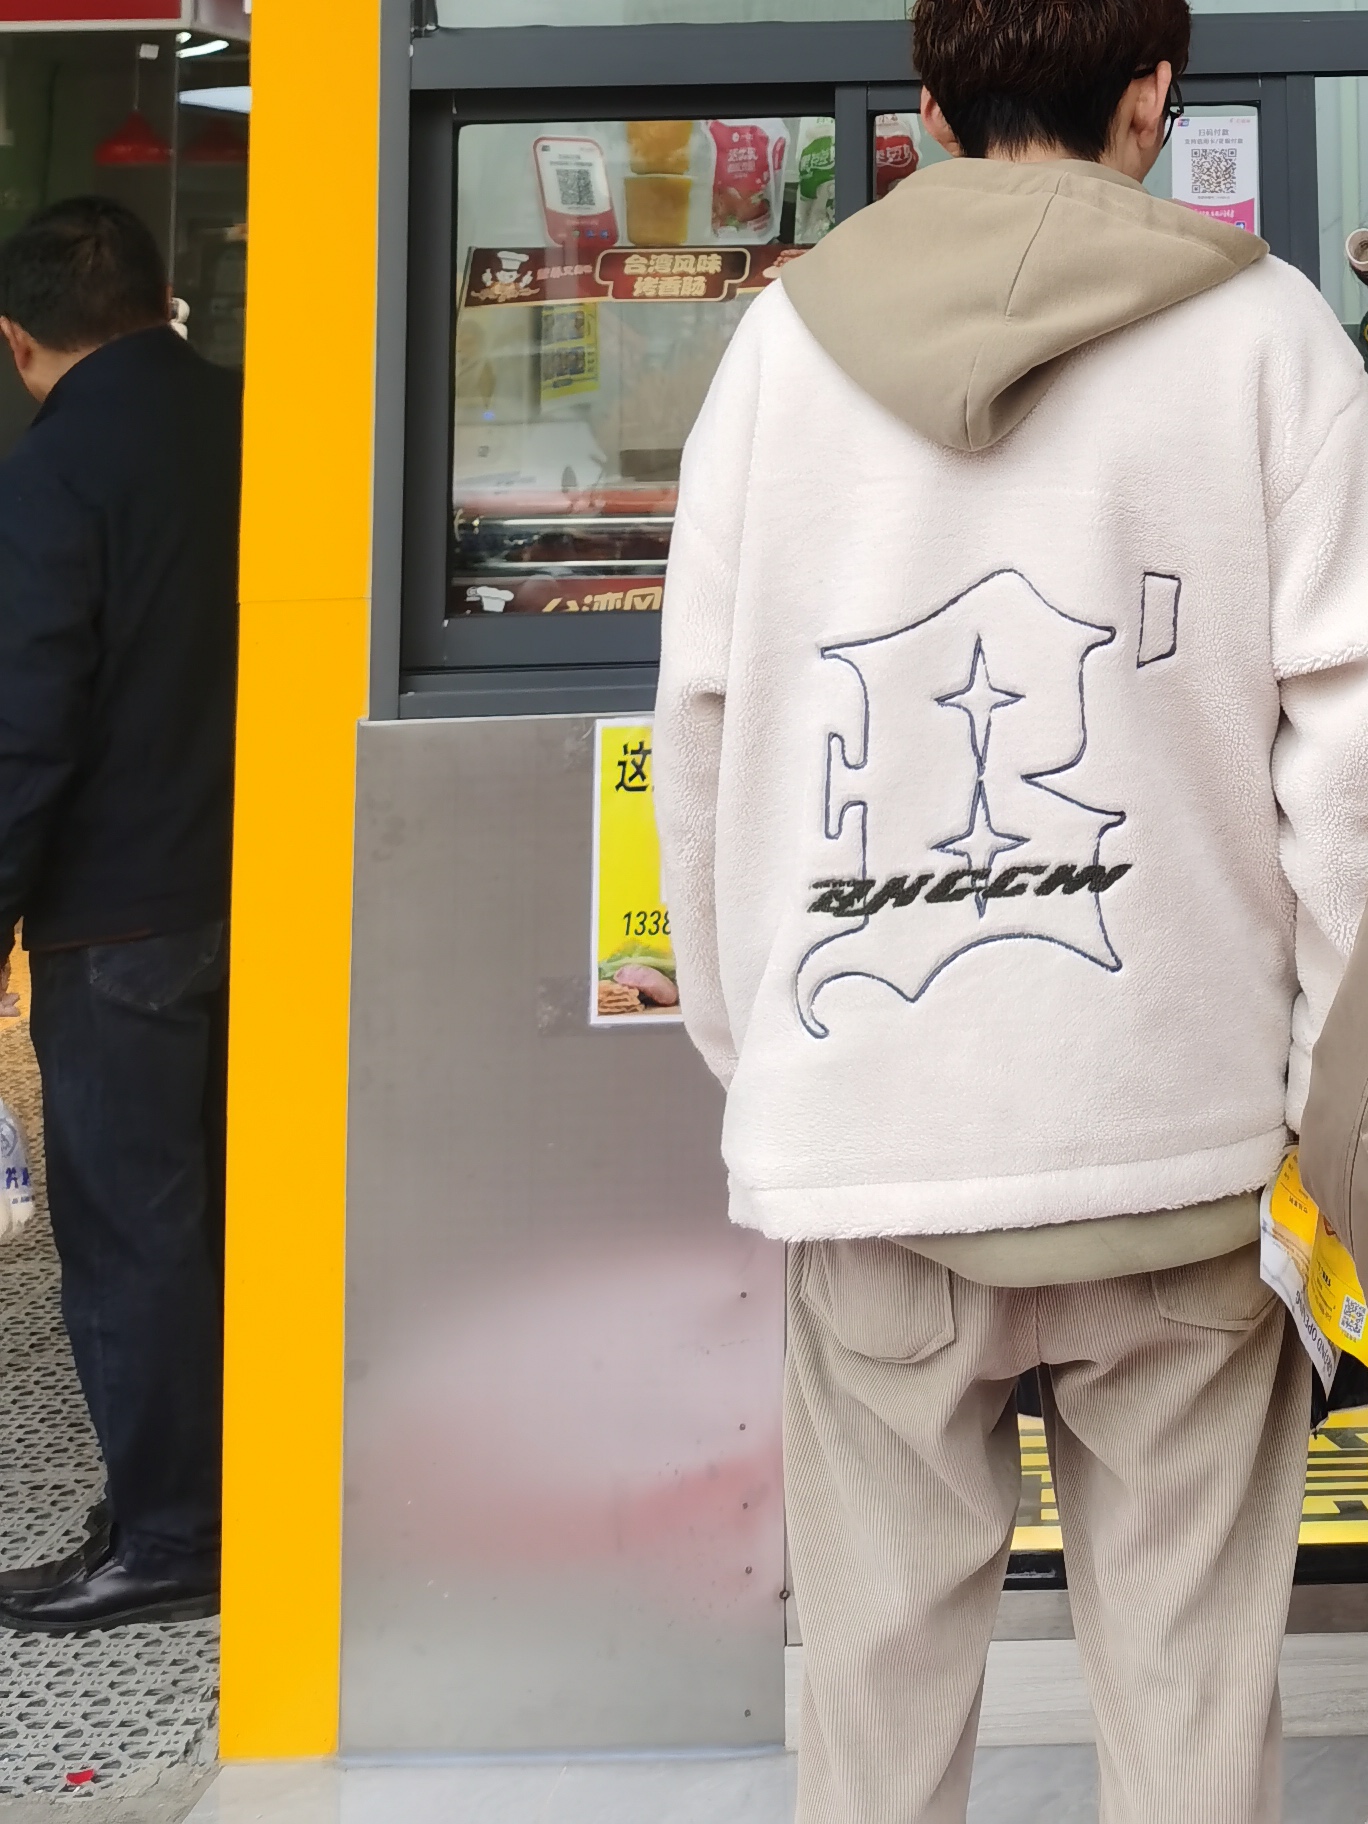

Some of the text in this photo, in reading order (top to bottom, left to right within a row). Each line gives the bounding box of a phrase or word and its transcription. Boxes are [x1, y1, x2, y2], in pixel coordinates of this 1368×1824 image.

[623, 254, 722, 275] 台湾风味
[633, 276, 707, 297] 烤香肠
